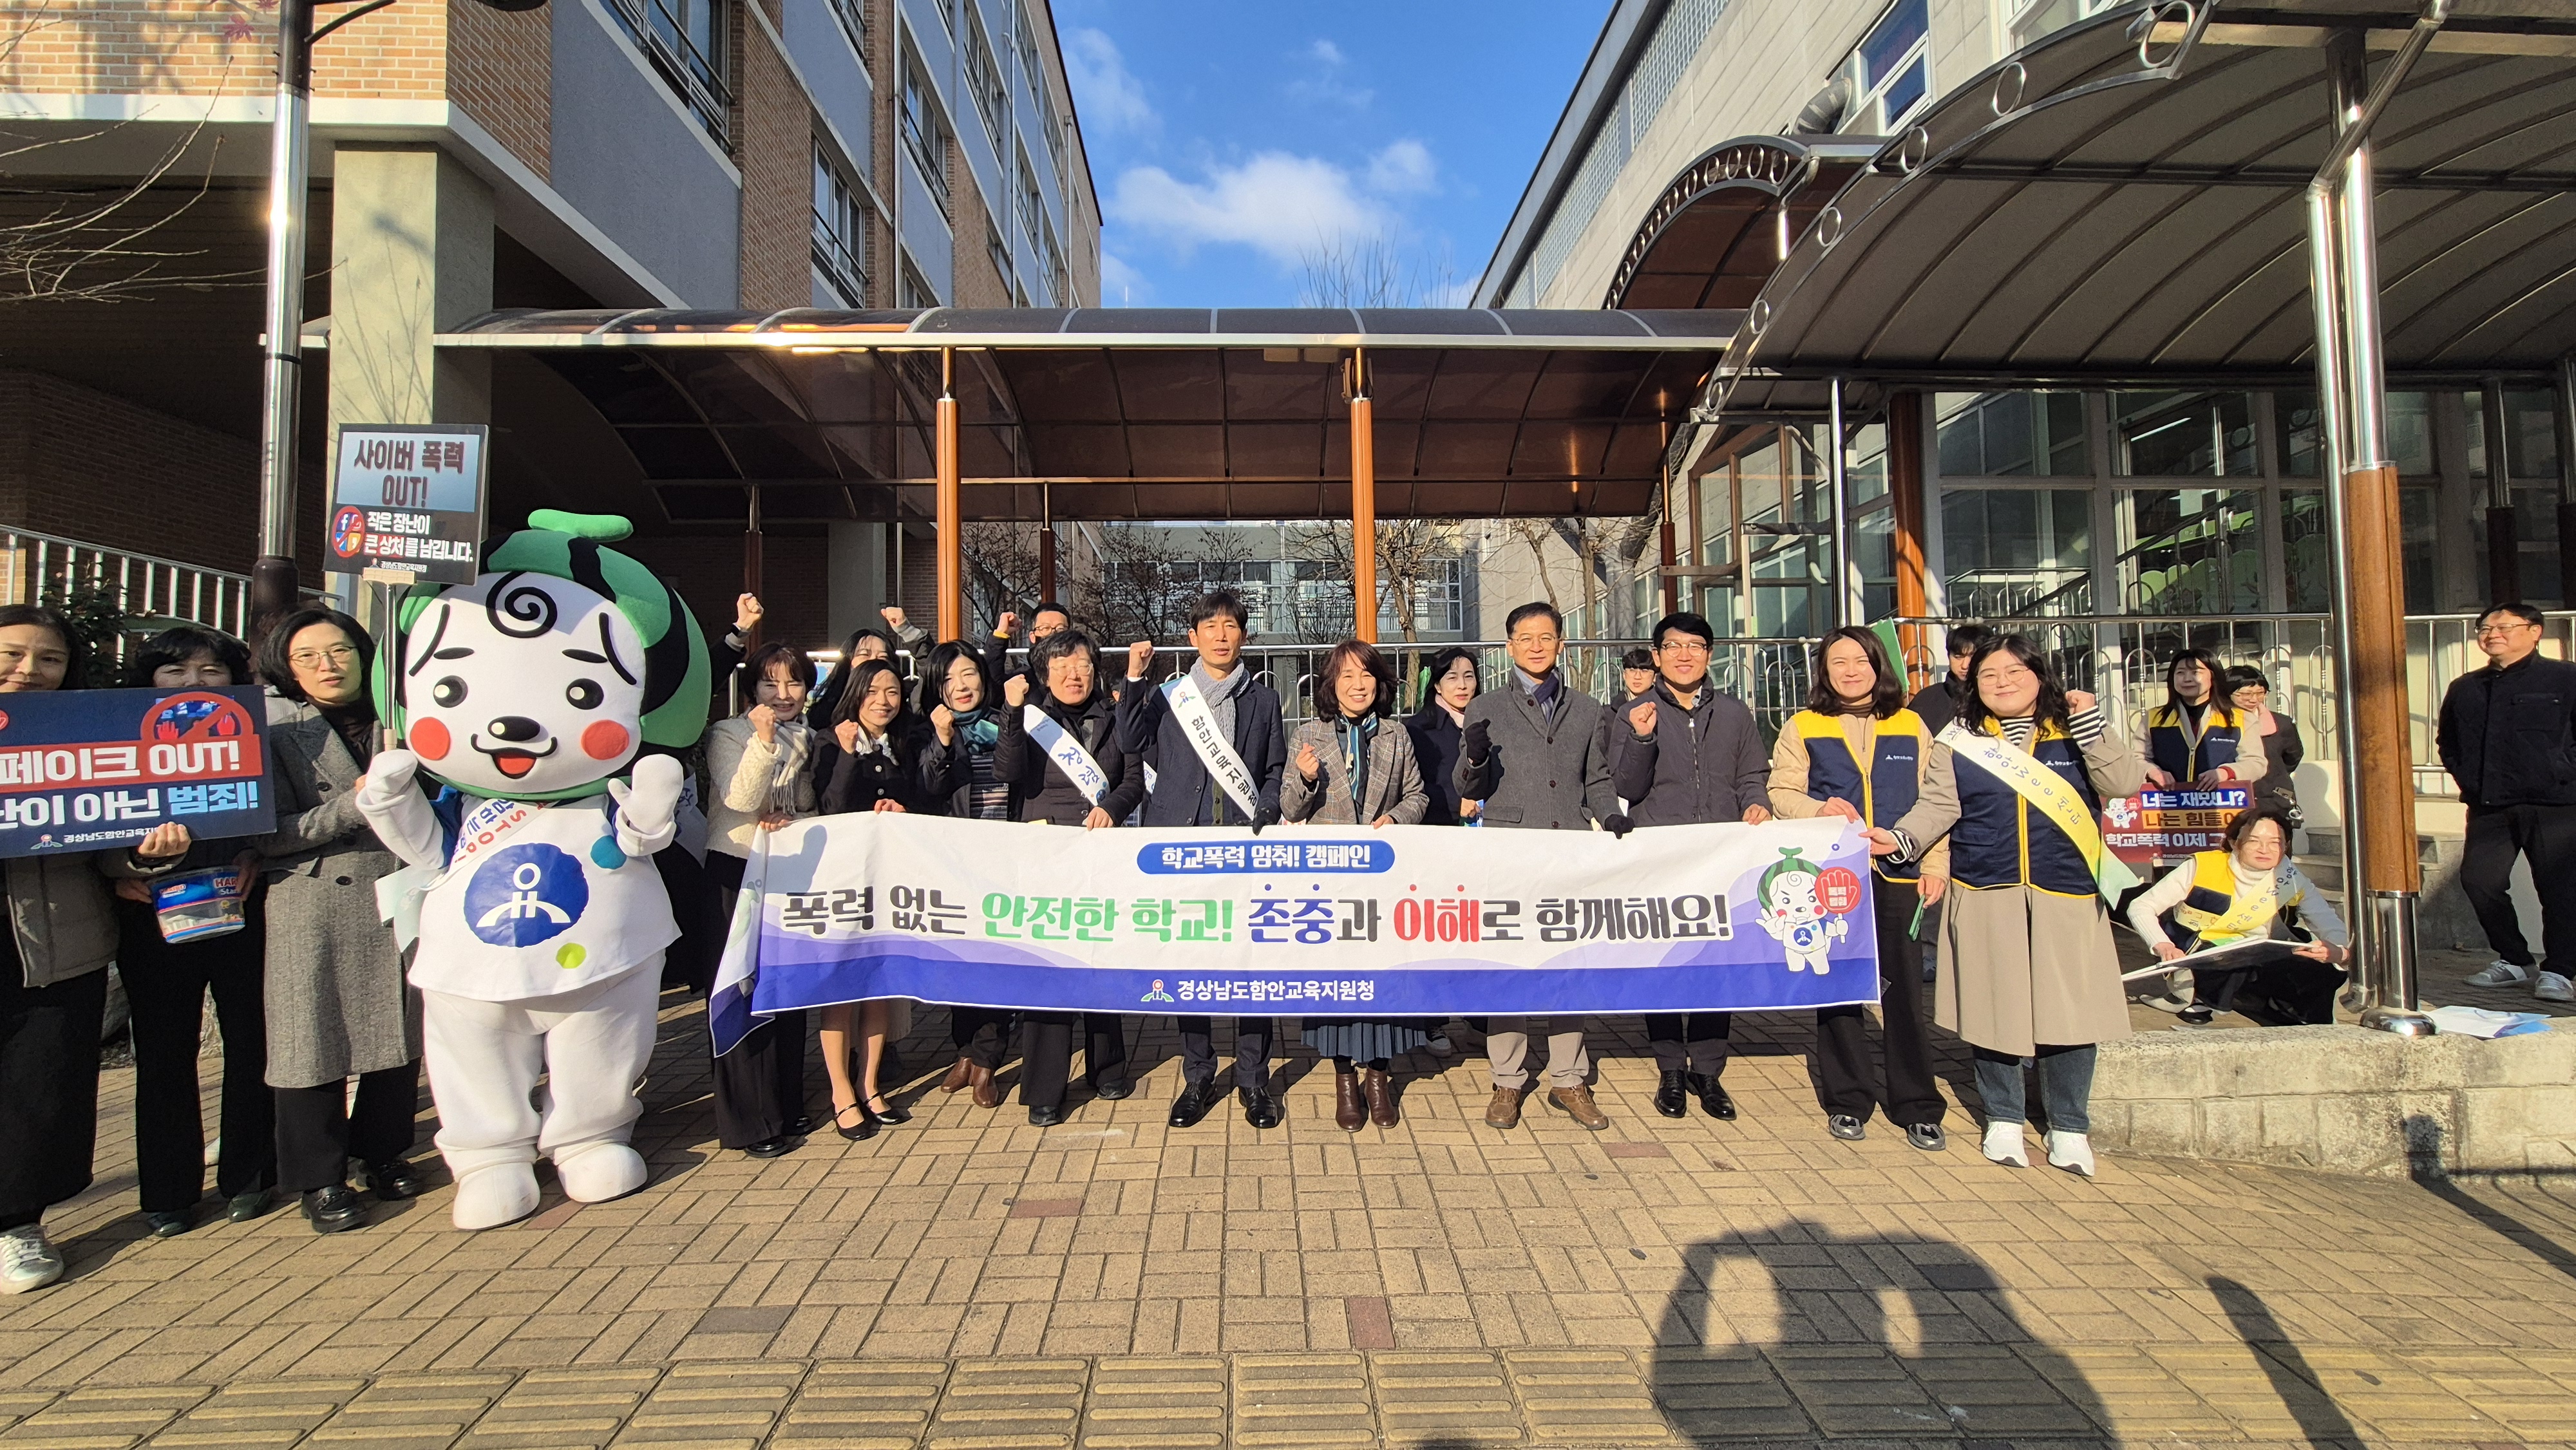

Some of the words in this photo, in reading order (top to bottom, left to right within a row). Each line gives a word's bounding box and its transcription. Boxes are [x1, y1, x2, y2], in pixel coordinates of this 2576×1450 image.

[354, 439, 414, 471] 사이버
[422, 440, 465, 474] 폭력
[382, 475, 428, 507] OUT!
[367, 511, 393, 532] 작은
[393, 513, 431, 535] 장난이
[364, 534, 379, 554] 큰
[419, 538, 474, 562] 남깁니다.
[149, 740, 240, 776] OUT!
[1191, 715, 1258, 807] 함안교육지원청
[73, 787, 160, 823] 아닌
[167, 780, 259, 816] 범죄!
[2142, 793, 2177, 807] 너는
[2146, 812, 2181, 827] 나는
[2105, 833, 2170, 847] 학교폭력
[2172, 833, 2206, 847] 이제
[1161, 845, 1245, 870] 학교폭력
[1251, 845, 1300, 868] 멈춰!
[1305, 845, 1370, 869] 캠페인
[783, 885, 874, 935] 폭력
[889, 885, 967, 935] 없는
[982, 892, 1119, 942] 안전한
[1131, 898, 1233, 943] 학교!
[1248, 898, 1382, 944] 존중과
[1394, 898, 1524, 942] 이해로
[1535, 894, 1730, 942] 함께해요!
[1177, 979, 1374, 1001] 경상남도함안교육지원청
